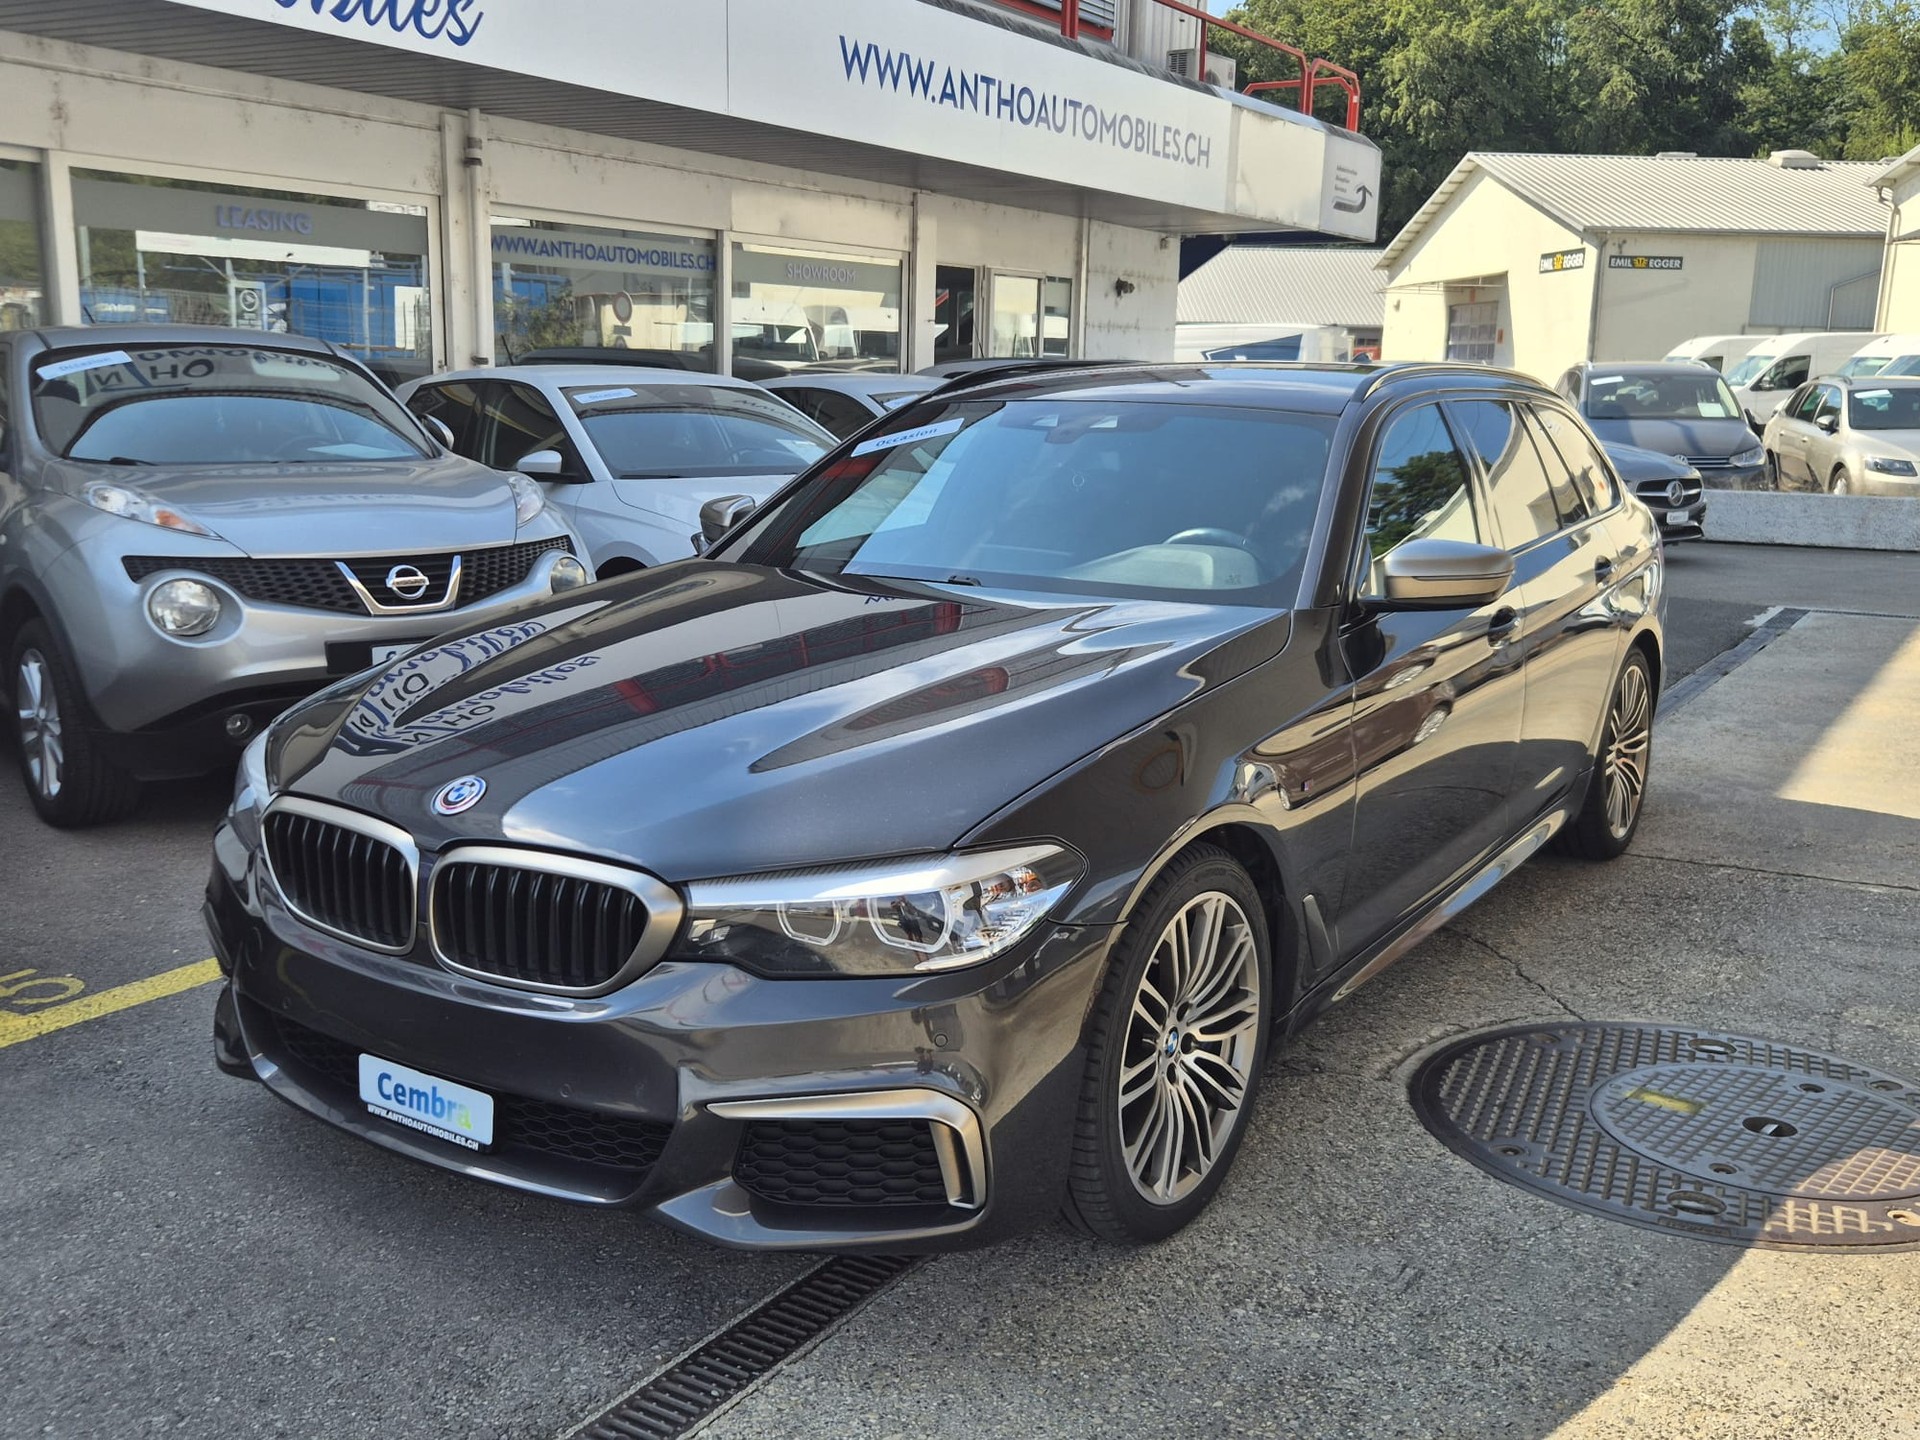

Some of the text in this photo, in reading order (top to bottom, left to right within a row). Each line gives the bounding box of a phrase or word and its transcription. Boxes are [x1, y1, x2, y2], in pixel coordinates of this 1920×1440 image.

[839, 35, 1211, 169] WWW.ANTHOAUTOMOBILES.CH
[216, 204, 314, 235] LEASING
[786, 263, 857, 283] SHOWROOM
[1610, 257, 1681, 269] EMIL EGGER
[875, 427, 938, 448] Occasion
[377, 1071, 472, 1130] Cembra
[367, 1103, 480, 1151] WWW.ANTHOAUTOMOBILES.CH
